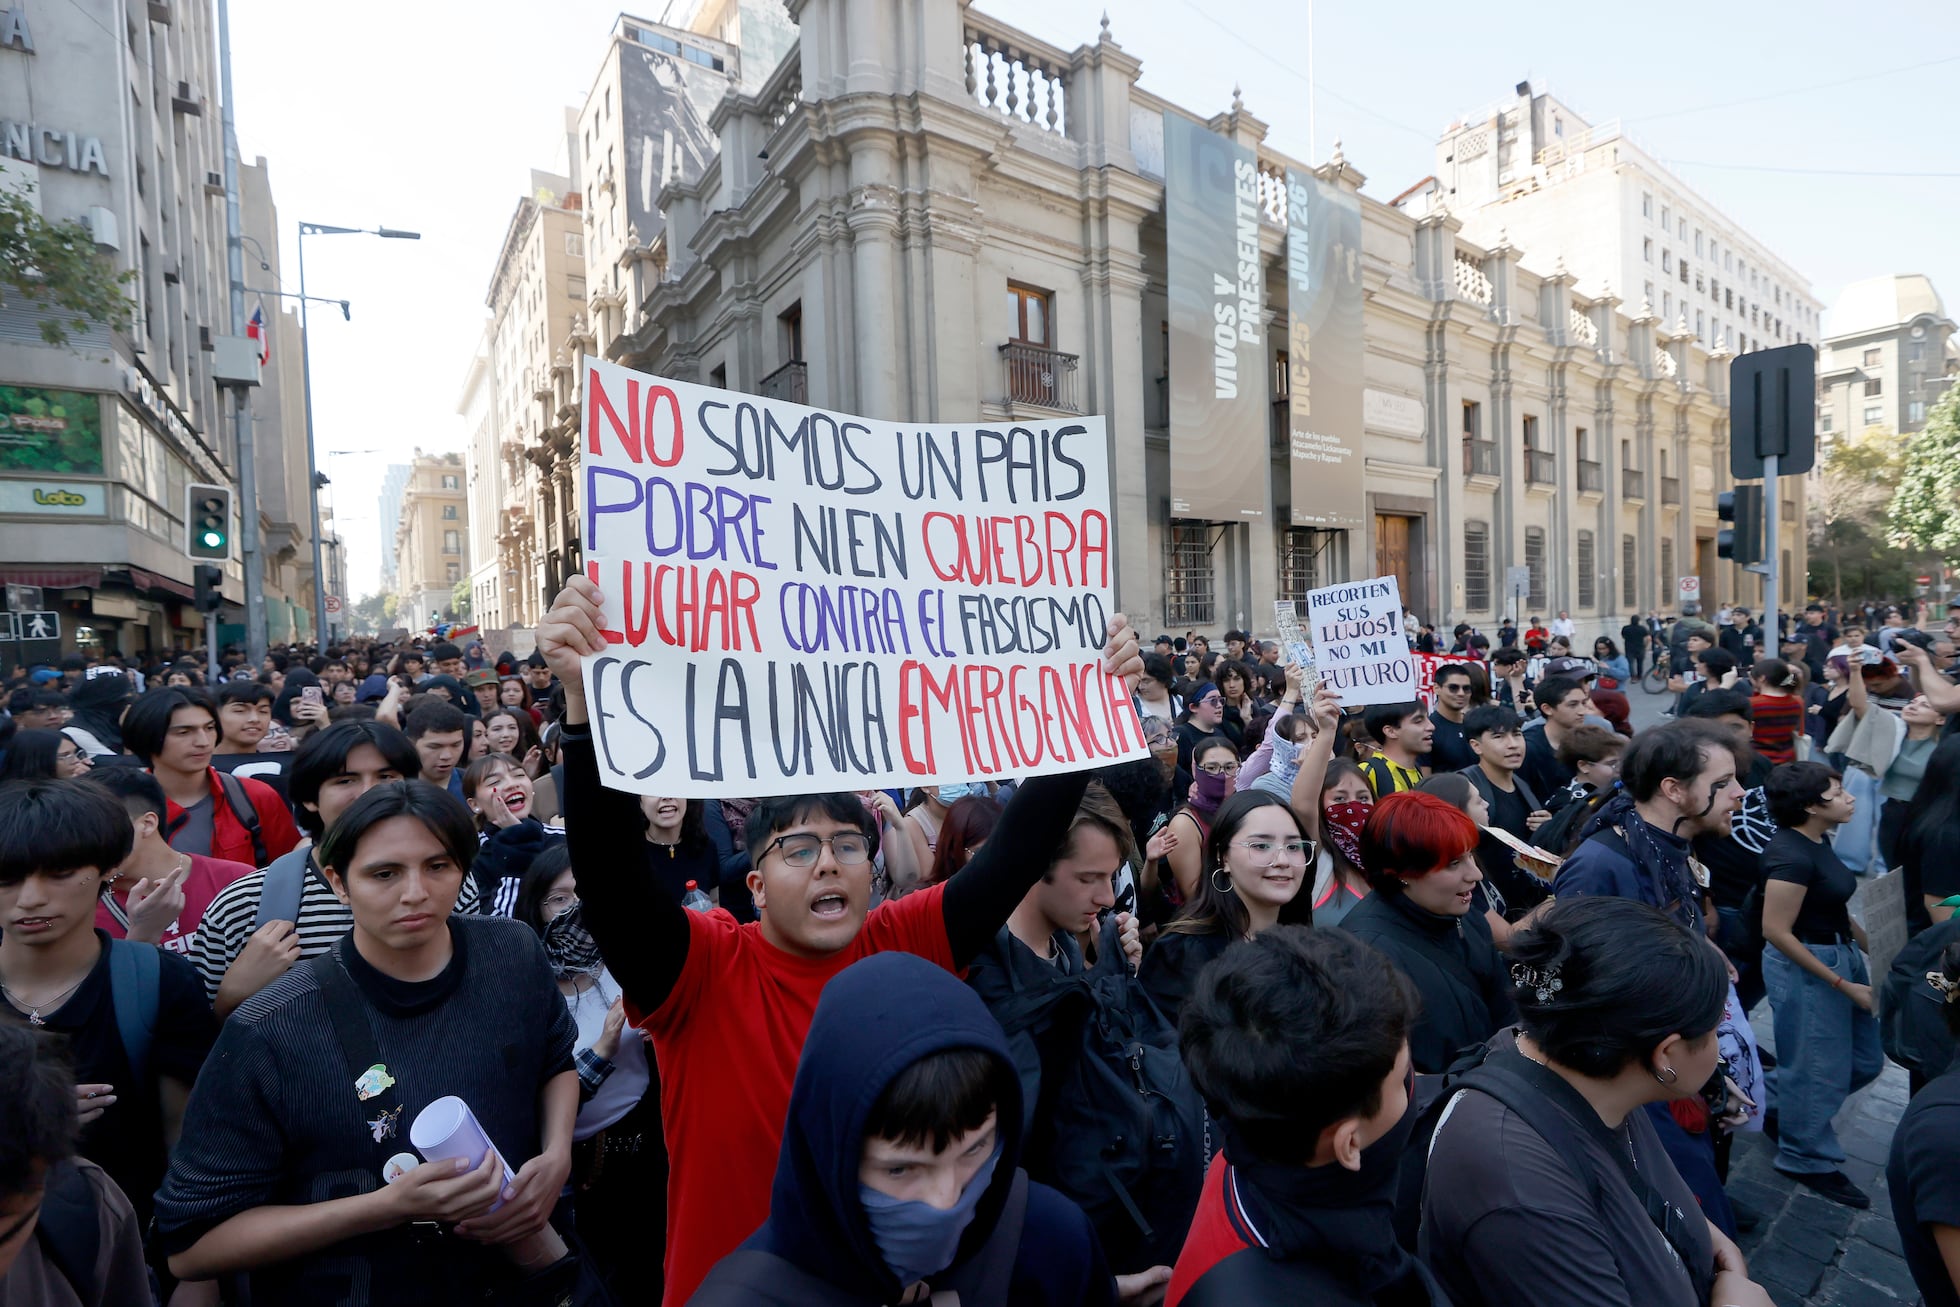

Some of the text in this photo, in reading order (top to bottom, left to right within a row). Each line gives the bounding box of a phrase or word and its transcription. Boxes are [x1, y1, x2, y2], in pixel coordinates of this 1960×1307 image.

[1234, 159, 1260, 345] PRESENTES
[1289, 230, 1309, 292] JUN
[1213, 272, 1238, 399] VIVOS Y
[1292, 361, 1311, 417] DIC
[588, 367, 1088, 504] NO SOMOS UN PAIS
[33, 488, 86, 506] Loto
[587, 465, 778, 570] POBRE
[922, 509, 1108, 588] QUIEBRA
[779, 581, 911, 655] CONTRA
[918, 588, 957, 658] EL
[958, 592, 1108, 655] FASCISMO
[1312, 582, 1391, 608] RECORTEN
[1337, 604, 1370, 622] SUS
[1321, 611, 1397, 642] LUJOS!
[1328, 640, 1387, 661] NO MI
[1320, 659, 1410, 690] FUTURO
[593, 657, 666, 781] ES
[686, 657, 756, 782] LA
[769, 661, 894, 777] UNICA
[898, 658, 1146, 776] EMERGENCIA
